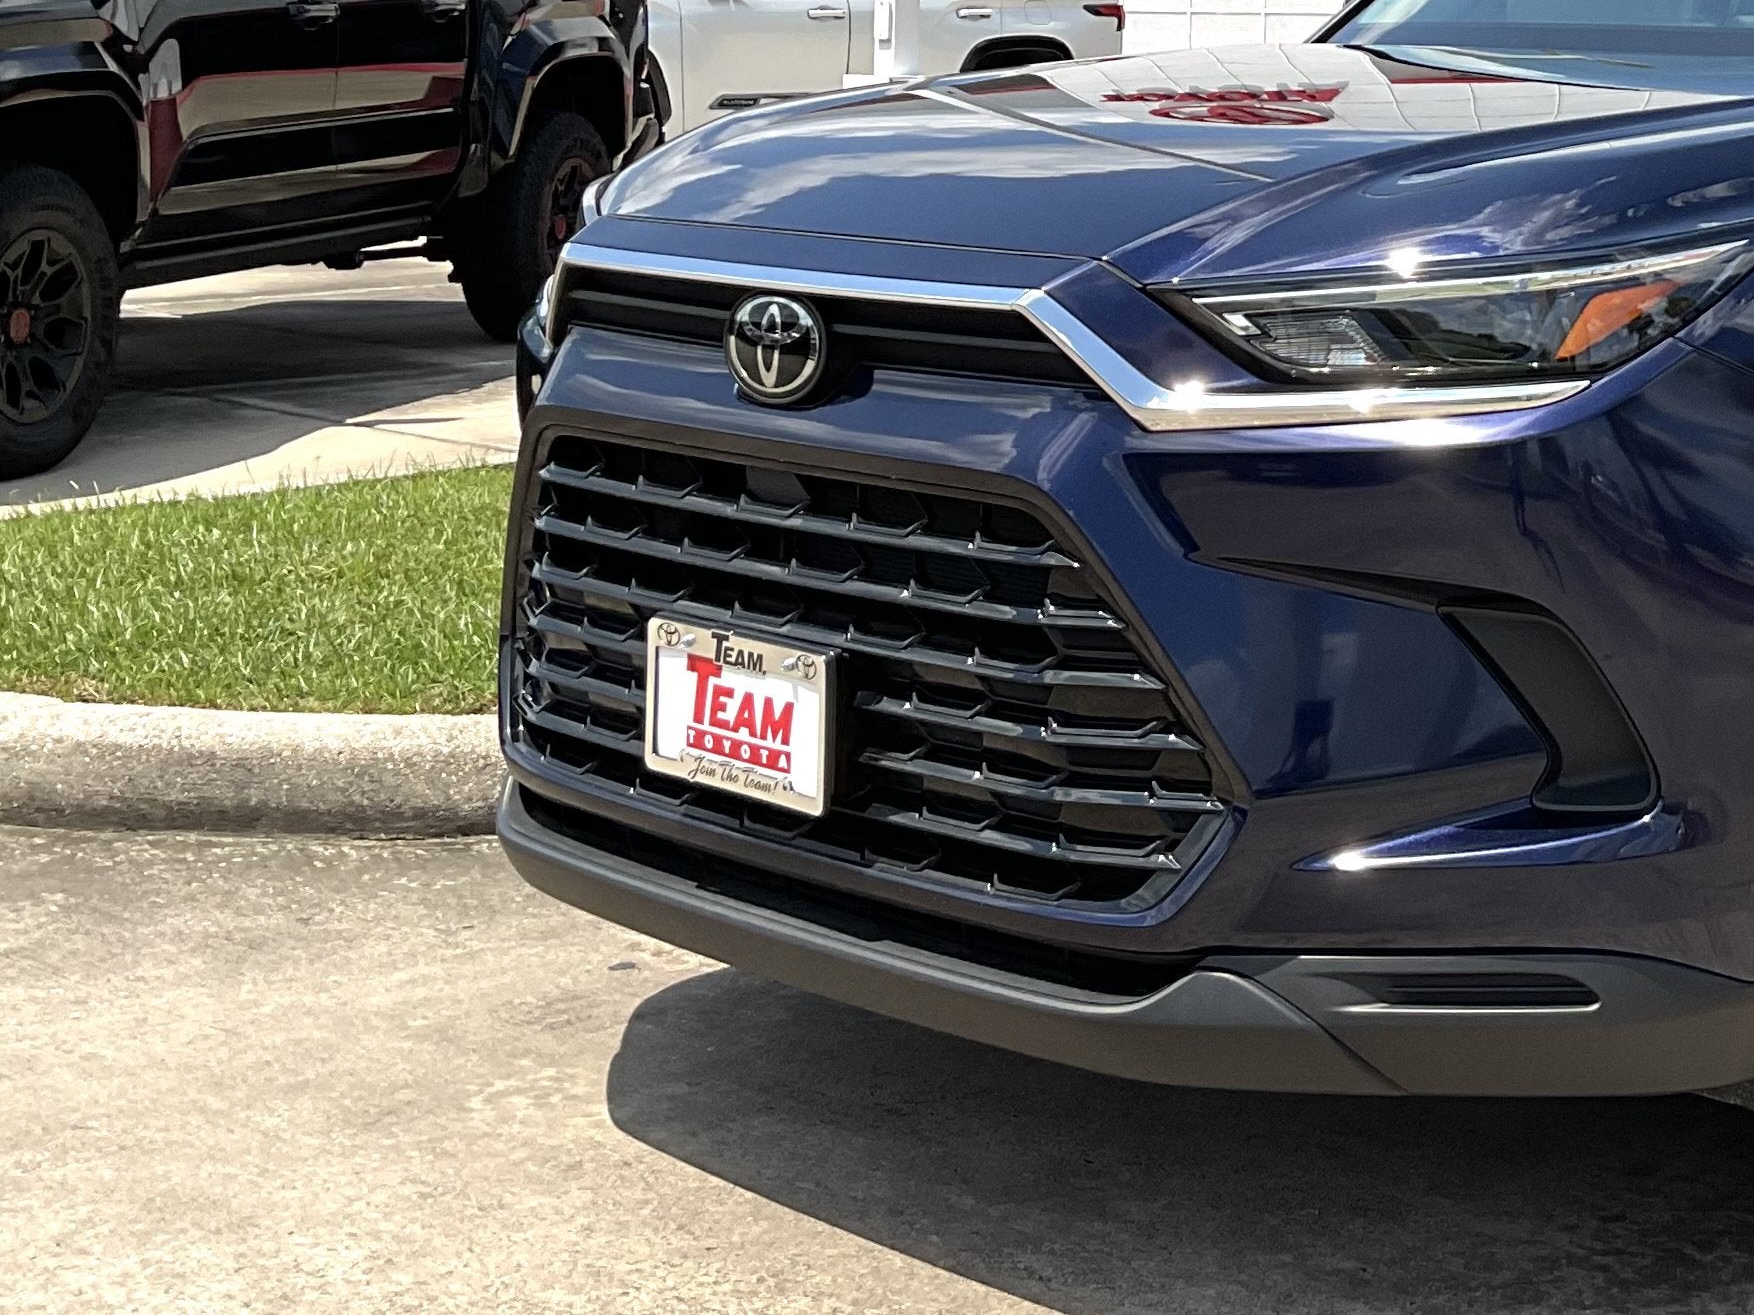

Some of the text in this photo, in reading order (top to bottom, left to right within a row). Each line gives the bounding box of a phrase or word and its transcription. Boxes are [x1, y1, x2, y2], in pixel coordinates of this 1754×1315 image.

[686, 653, 794, 746] TEAM
[687, 729, 789, 770] TOYOTA
[688, 753, 779, 795] Join The Team!
